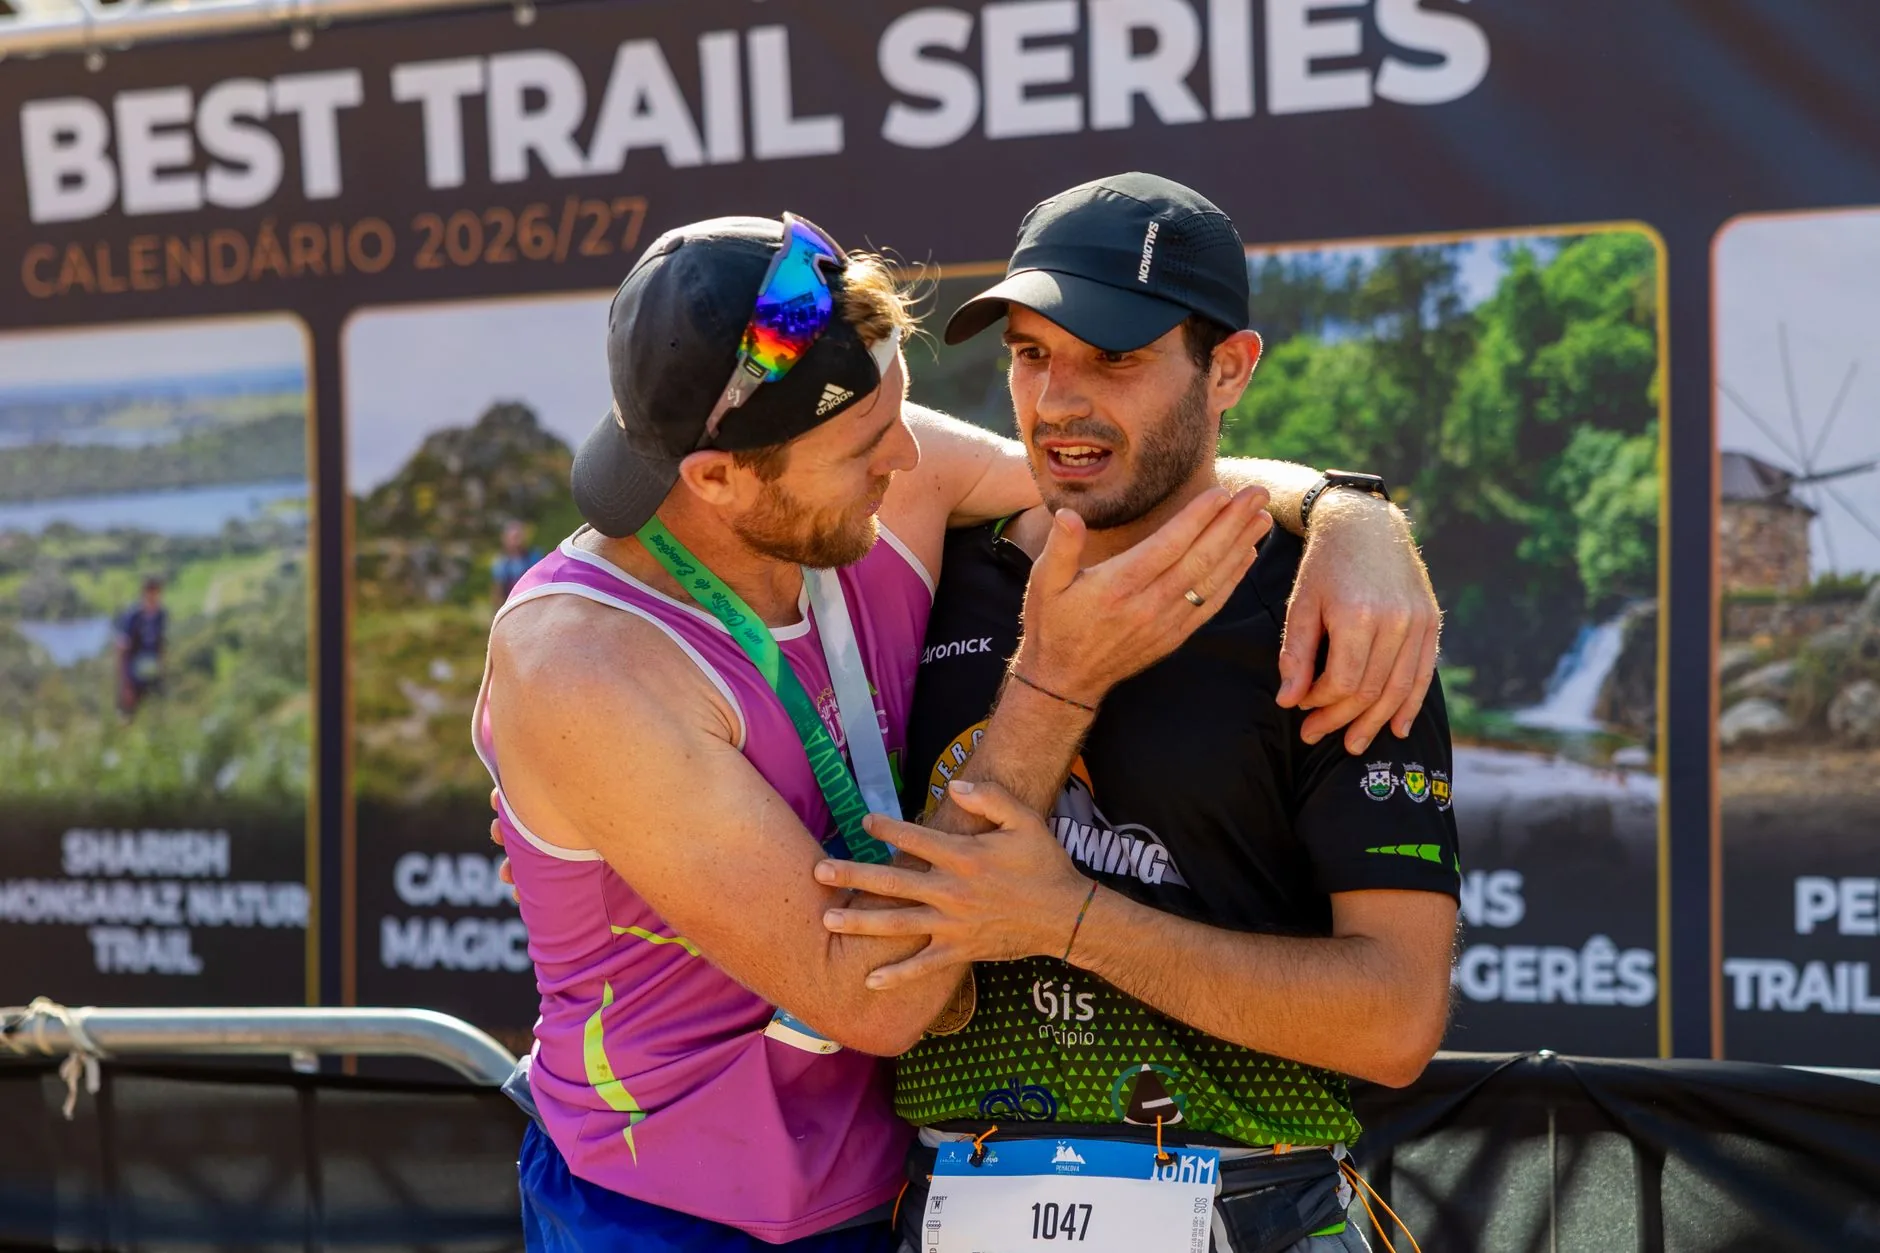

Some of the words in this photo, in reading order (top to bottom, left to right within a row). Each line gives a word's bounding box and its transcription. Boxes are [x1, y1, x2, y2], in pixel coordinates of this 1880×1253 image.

[20, 67, 364, 223] BEST
[390, 24, 845, 189] TRAIL
[877, 0, 1491, 148] SERIES
[21, 215, 396, 297] CALENDÁRIO
[412, 196, 649, 270] 2026/27
[1138, 220, 1159, 284] SALOMON
[815, 390, 854, 416] adidas
[62, 829, 230, 877] SHARISH
[87, 926, 204, 974] TRAIL
[1723, 957, 1880, 1015] TRAIL
[1032, 1202, 1093, 1241] 1047
[1194, 1197, 1208, 1214] SOS
